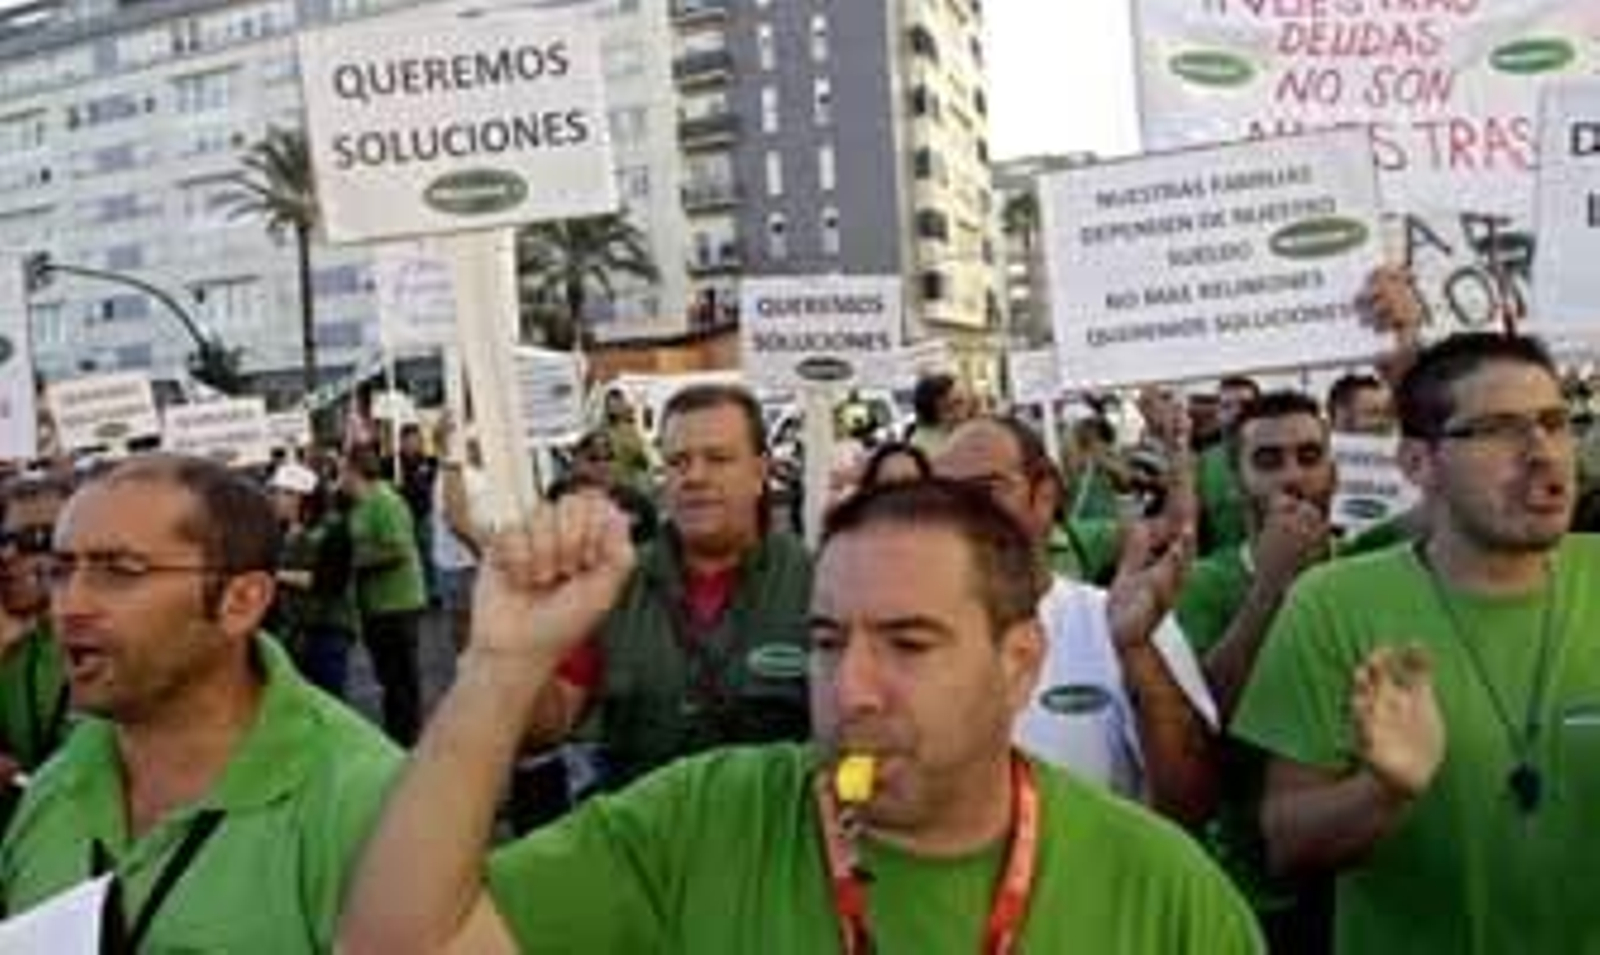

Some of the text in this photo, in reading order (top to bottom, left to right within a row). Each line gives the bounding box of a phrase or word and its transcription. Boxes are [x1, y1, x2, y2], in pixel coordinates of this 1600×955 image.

[1277, 21, 1442, 56] DEUDAS
[333, 41, 570, 103] QUEREMOS
[1277, 66, 1452, 106] NO SON
[333, 109, 588, 170] SOLUCIONES
[1096, 179, 1205, 209] NUESTRAS
[1080, 215, 1193, 246] DEPENDEN
[1199, 209, 1227, 230] DE
[757, 293, 884, 318] QUEREMOS
[1106, 291, 1139, 310] NO
[753, 331, 891, 352] SOLUCIONES
